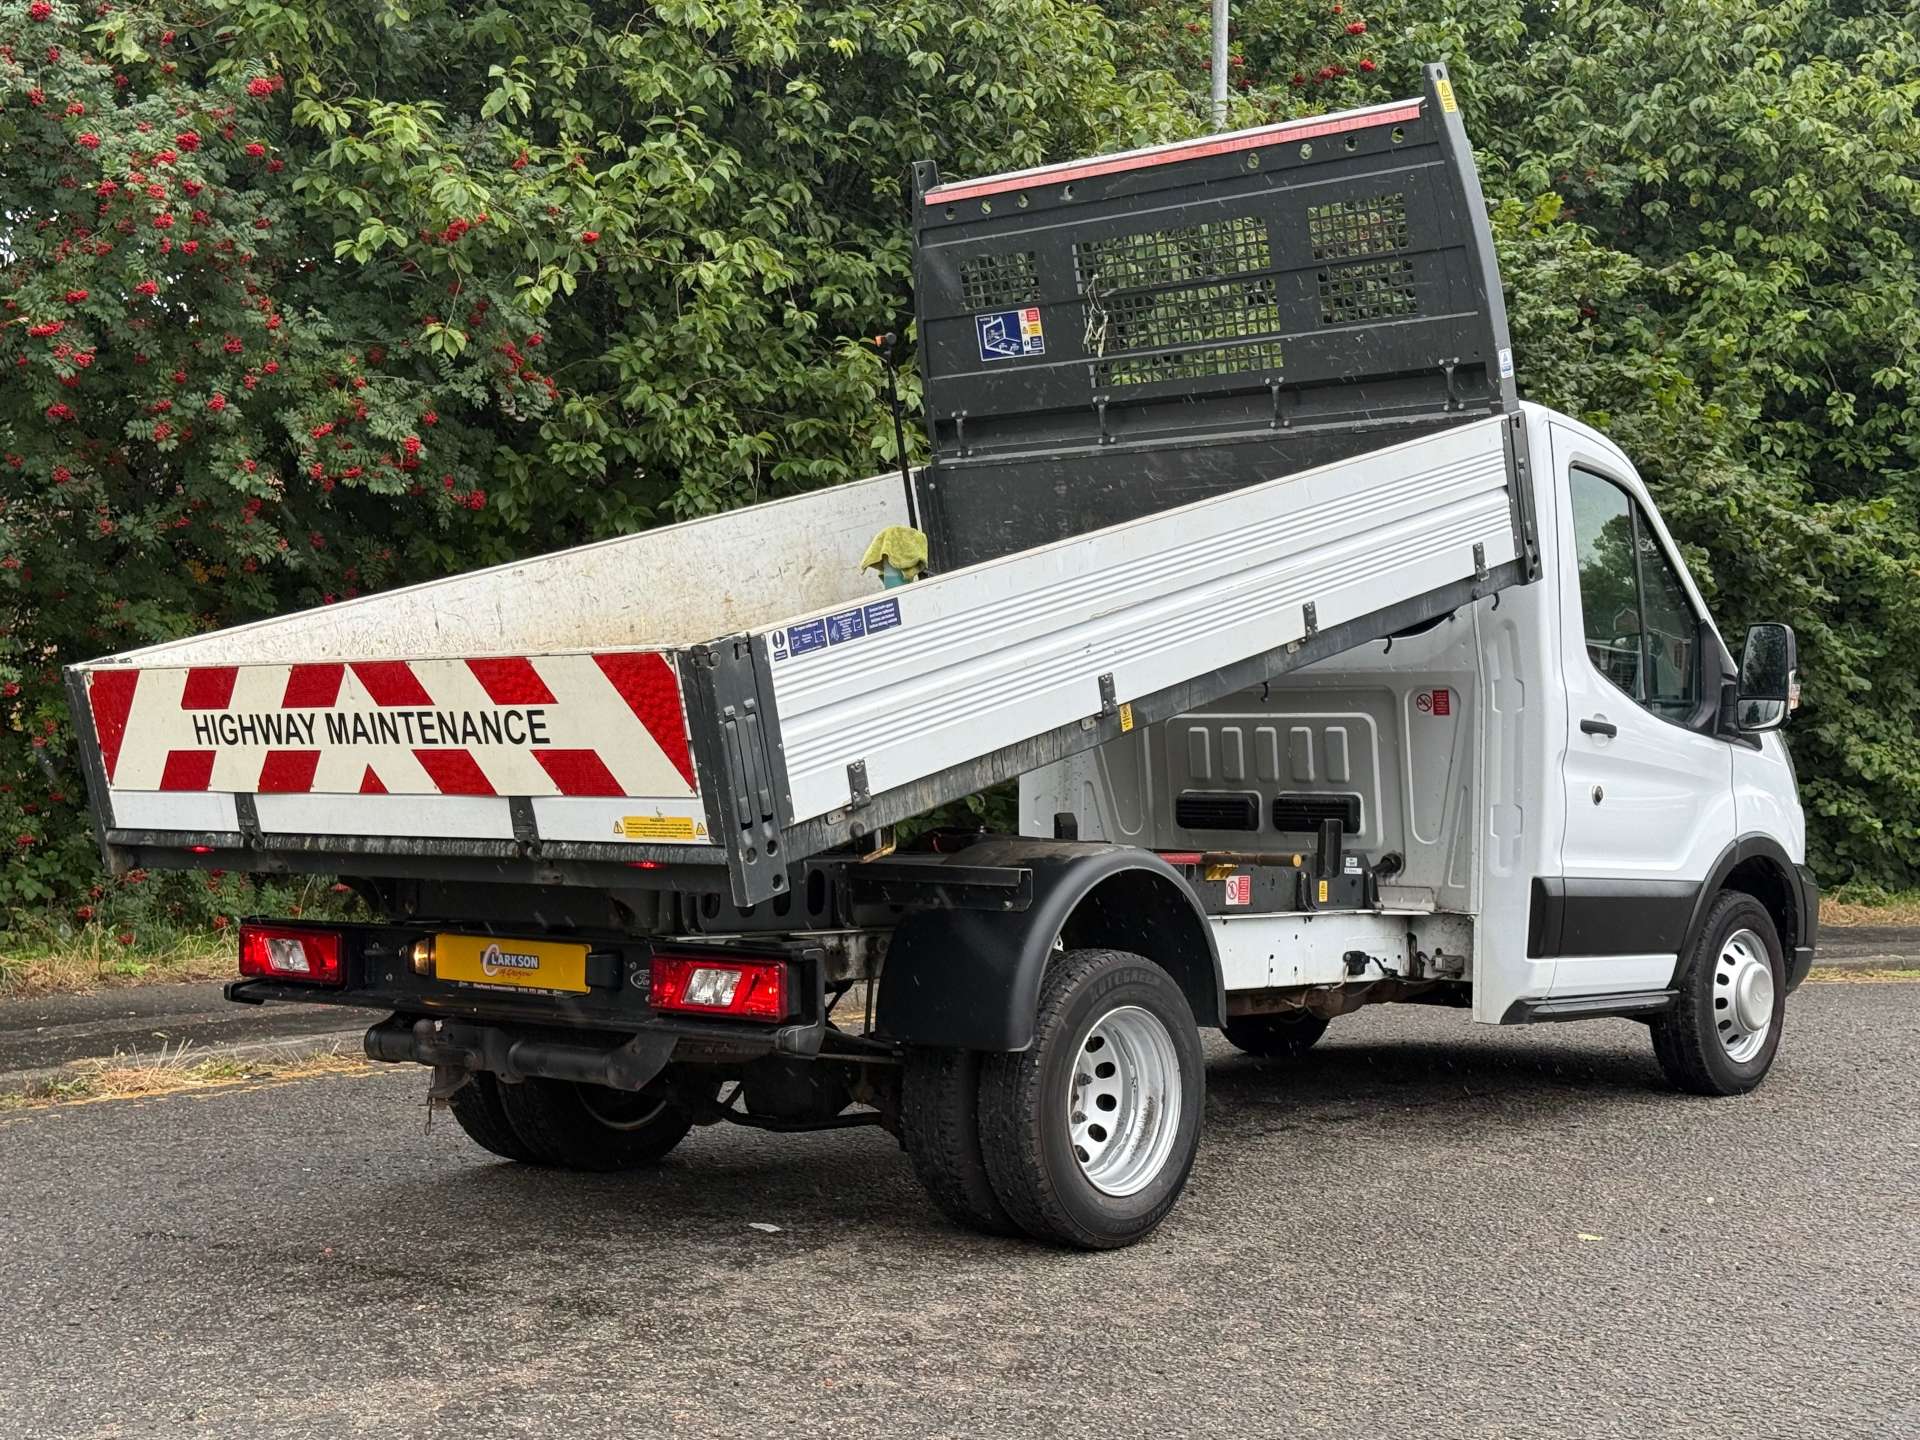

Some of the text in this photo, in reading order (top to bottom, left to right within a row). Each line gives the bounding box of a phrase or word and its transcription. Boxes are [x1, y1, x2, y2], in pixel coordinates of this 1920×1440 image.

[192, 710, 551, 745] HIGHWAY MAINTENANCE
[482, 943, 539, 976] CLARKSON
